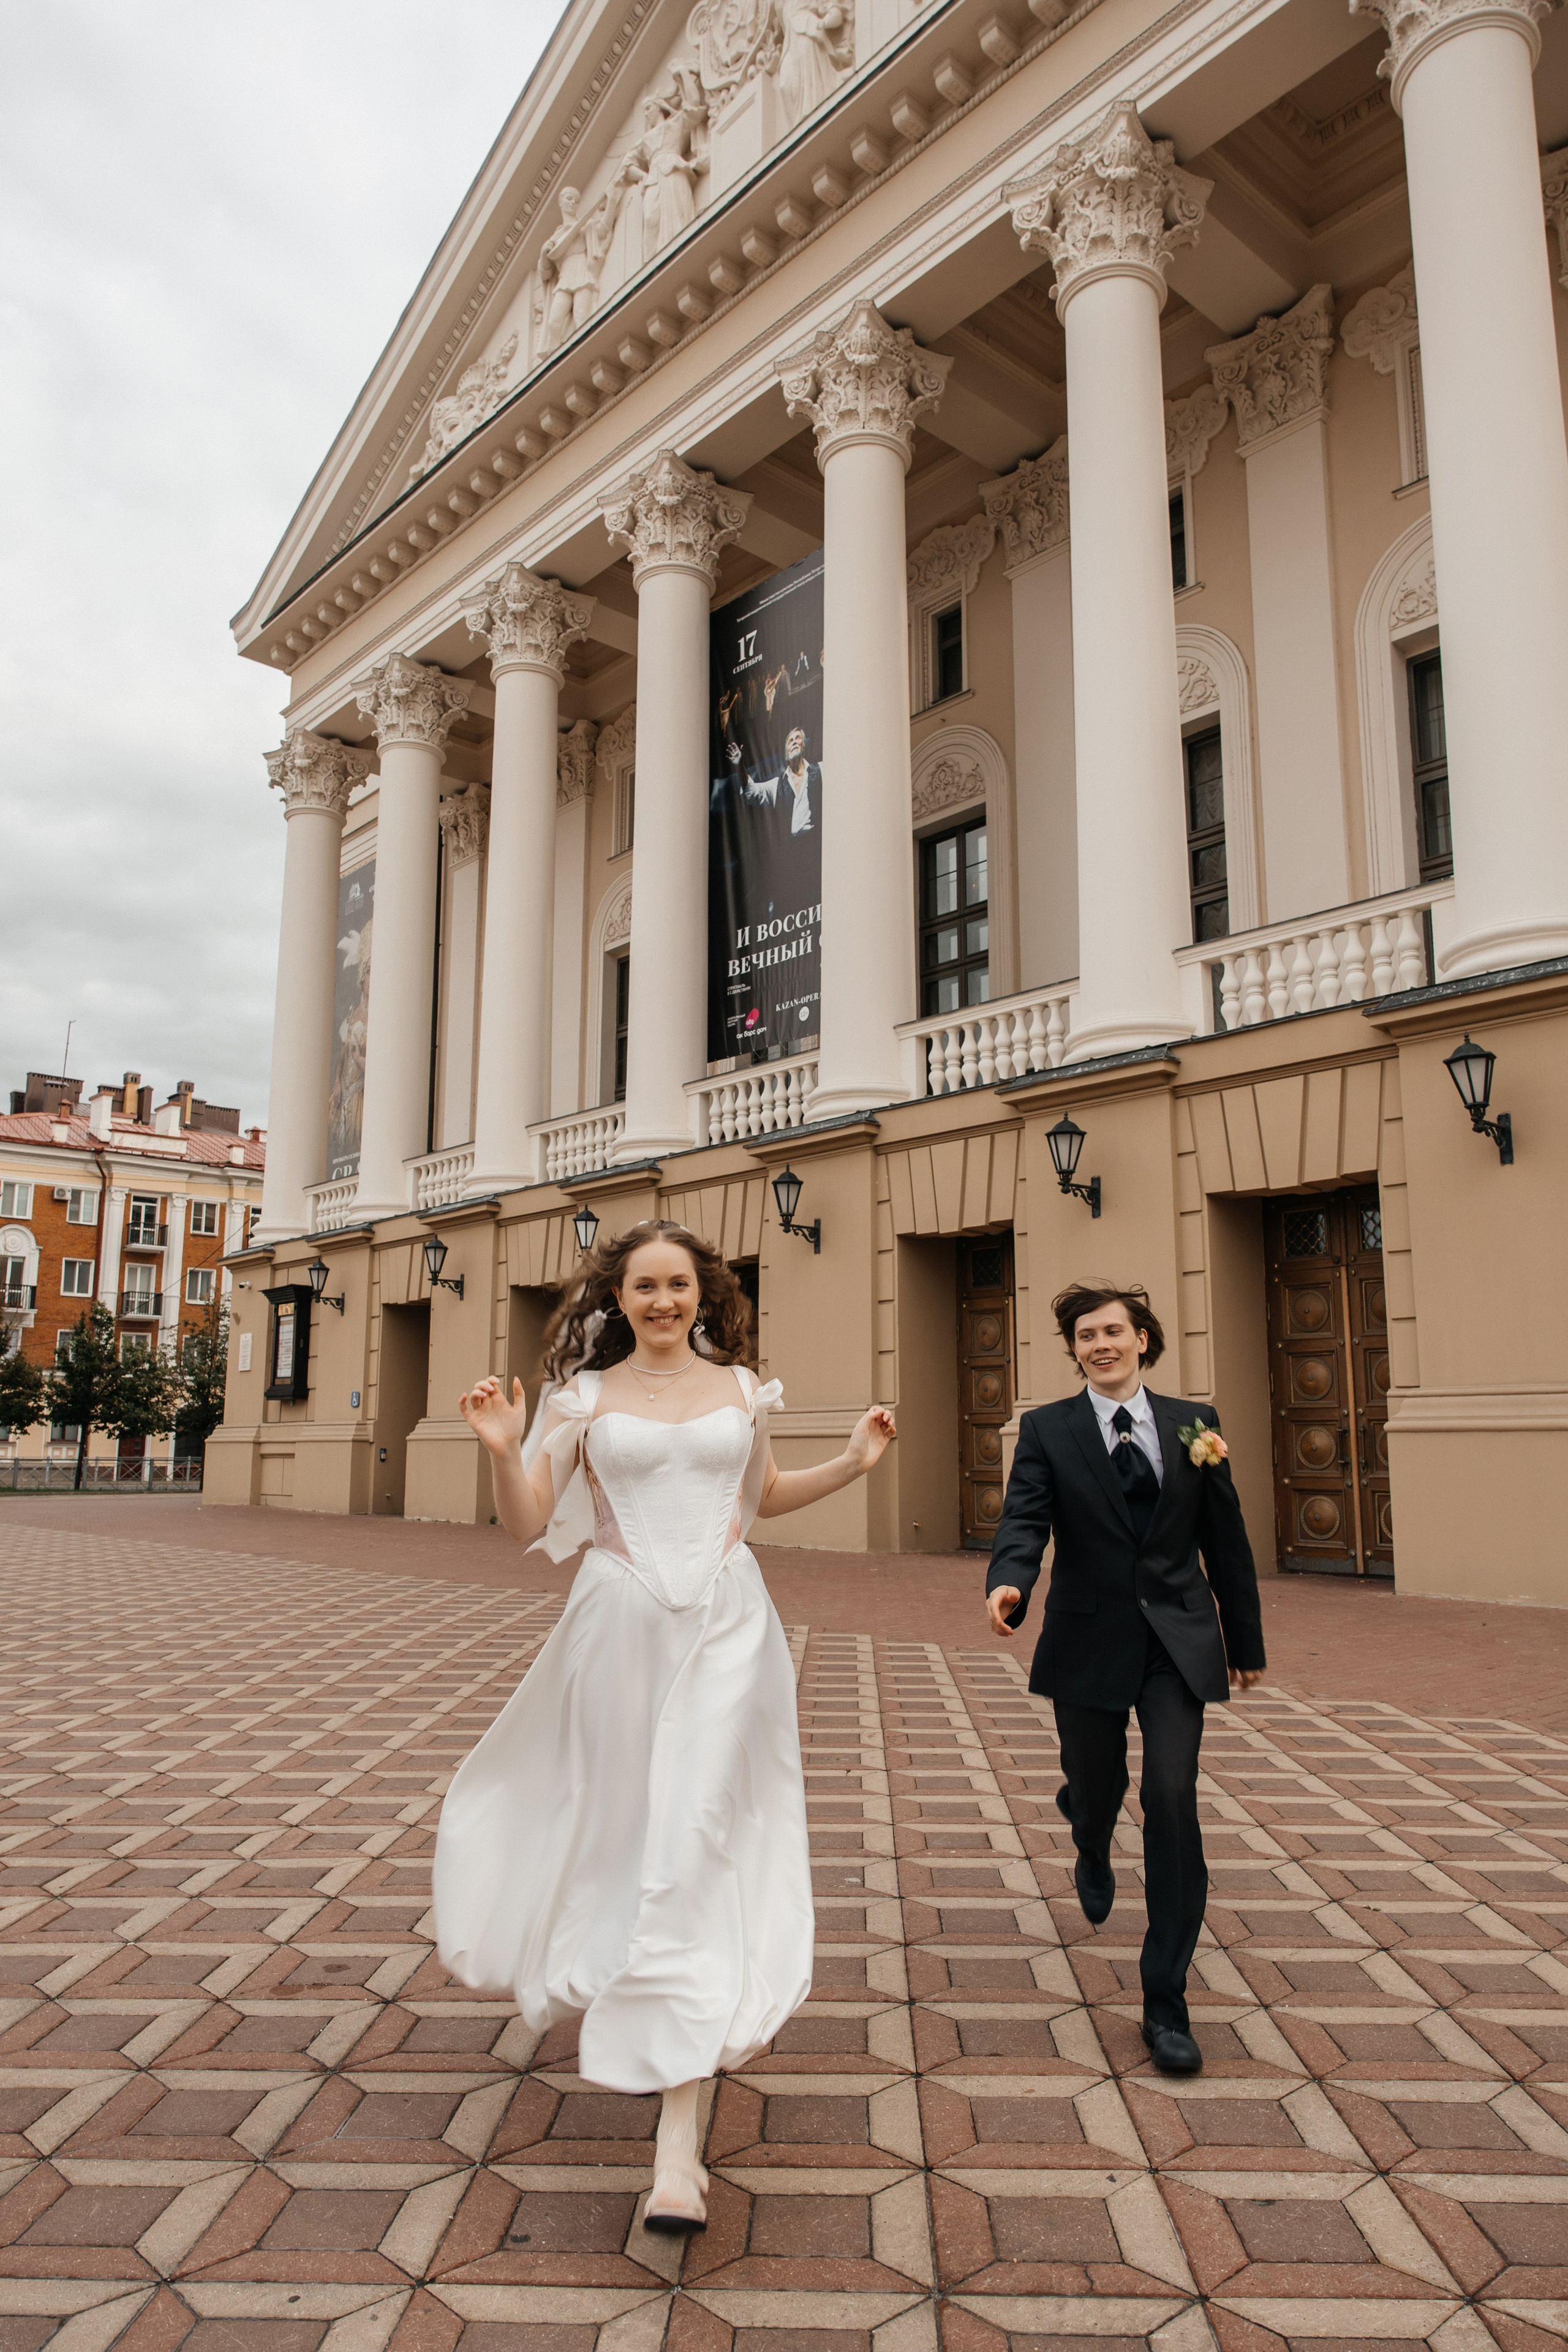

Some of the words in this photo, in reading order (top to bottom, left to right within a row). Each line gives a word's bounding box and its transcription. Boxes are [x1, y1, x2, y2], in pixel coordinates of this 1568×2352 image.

[737, 630, 758, 662] 17
[733, 653, 763, 674] СЕНТЯБРЯ
[736, 925, 750, 949] И
[728, 929, 813, 978] ВЕЧНЫЙ
[776, 992, 821, 1012] KAZAN-OPER
